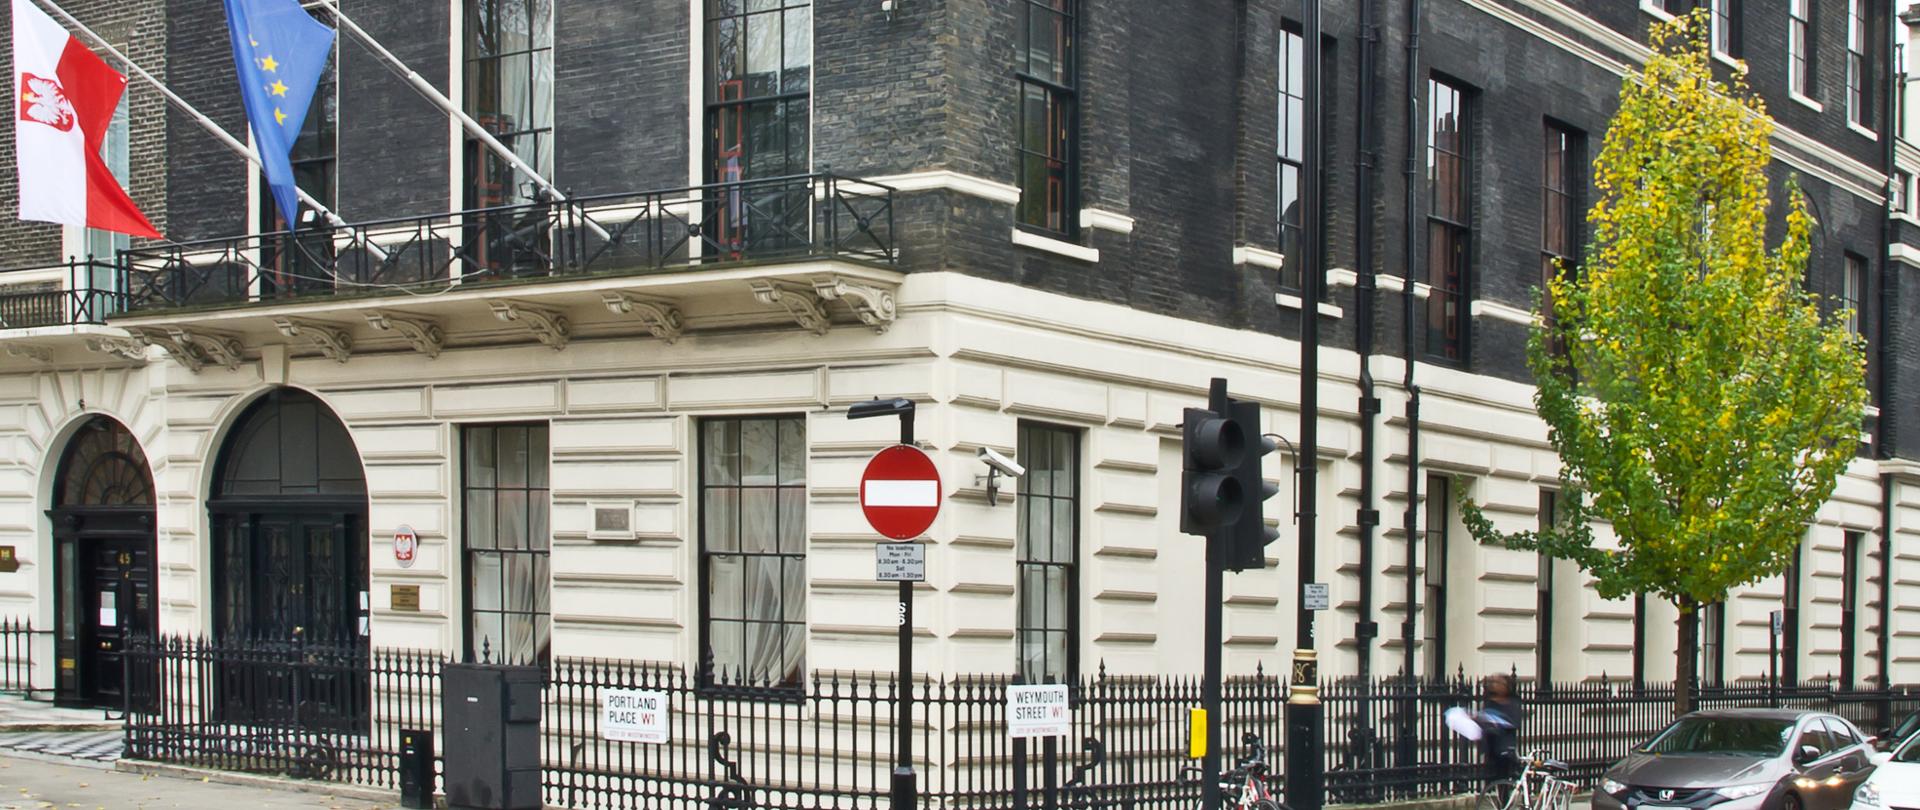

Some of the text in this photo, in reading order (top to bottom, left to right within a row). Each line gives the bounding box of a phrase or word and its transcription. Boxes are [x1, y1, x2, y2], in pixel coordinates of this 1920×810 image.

[609, 695, 657, 710] PORTLAND
[1015, 691, 1064, 704] WEYMOUTH
[609, 710, 655, 726] PLACE W1
[1016, 706, 1063, 720] STREET W1
